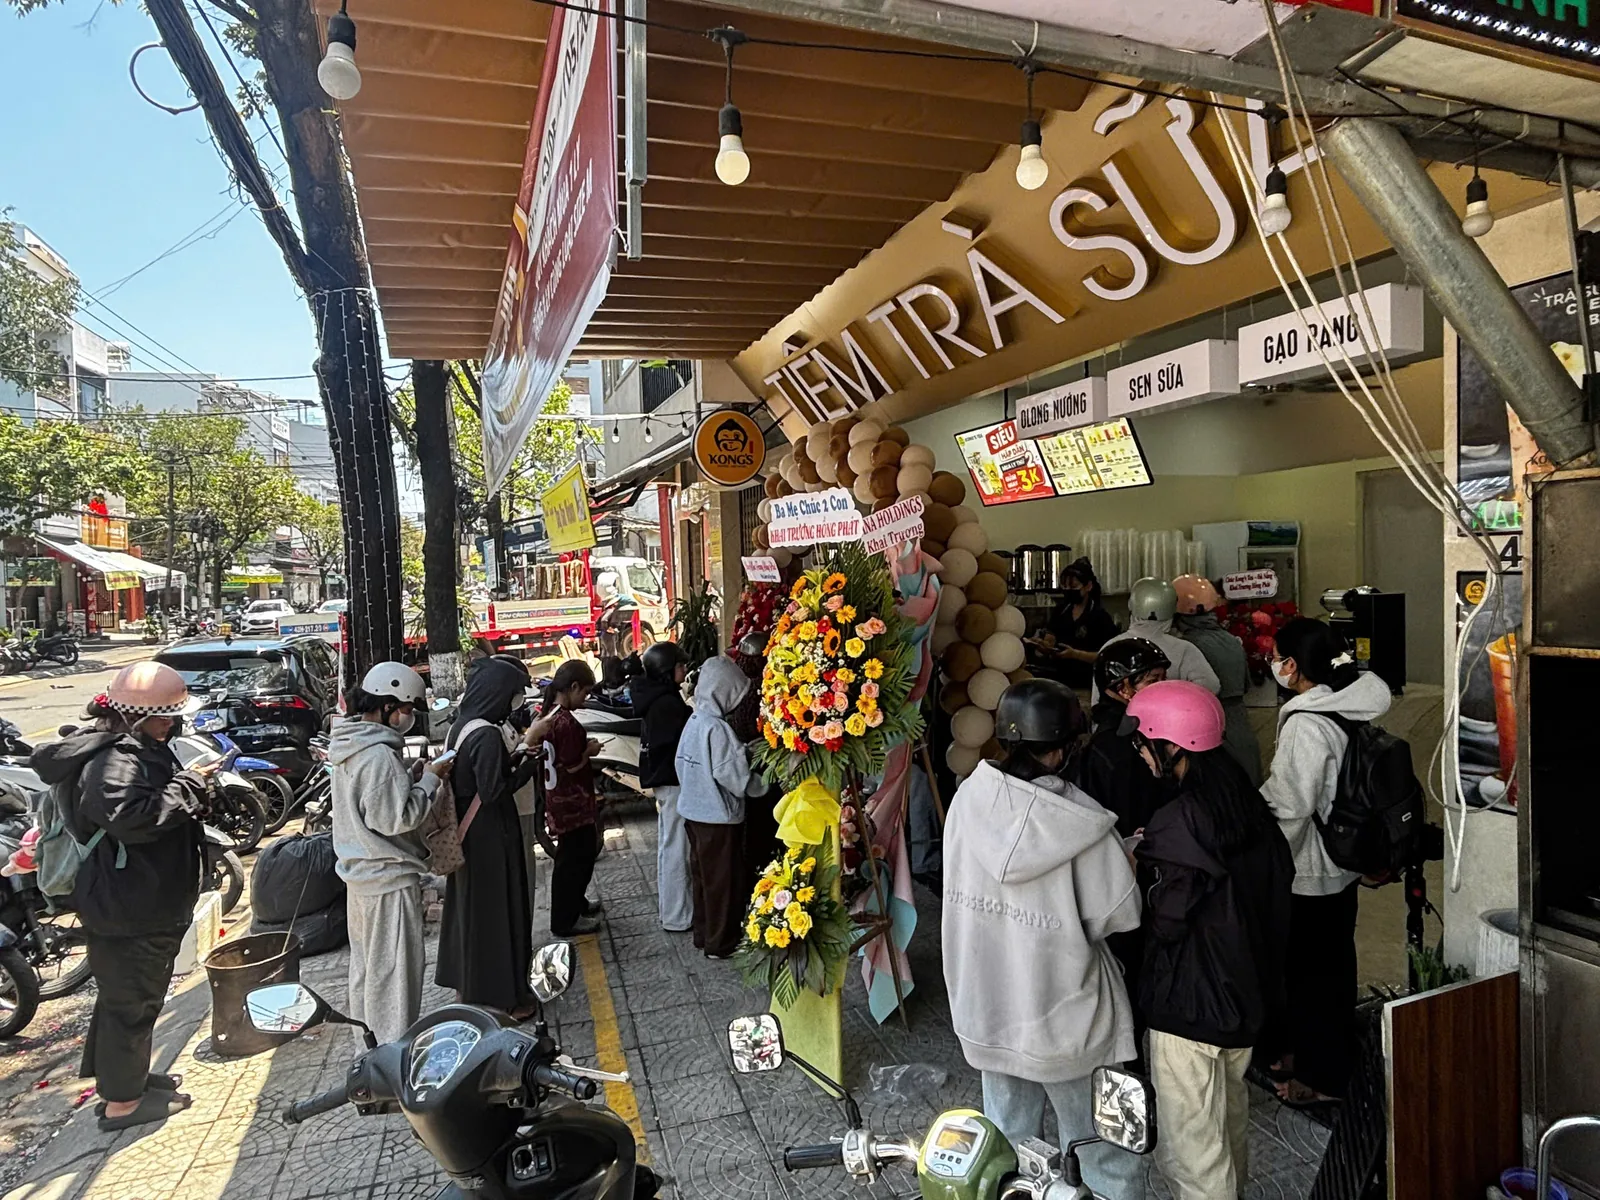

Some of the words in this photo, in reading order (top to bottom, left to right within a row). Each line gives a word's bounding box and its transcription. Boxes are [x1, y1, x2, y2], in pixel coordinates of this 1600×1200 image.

[865, 219, 1067, 380] TRÀ
[1264, 328, 1298, 364] GẠO
[1307, 313, 1359, 353] RANG
[1129, 374, 1152, 401] SEN
[1157, 362, 1184, 393] SỮA
[1020, 404, 1050, 430] OLONG
[1053, 392, 1087, 421] NƯỚNG
[989, 425, 1015, 451] SIÊU
[708, 453, 754, 465] KONG'S
[1025, 450, 1036, 468] 2
[1016, 467, 1041, 491] 3K
[774, 503, 786, 519] Ba
[786, 501, 799, 521] Mẹ
[799, 497, 821, 516] Chúc
[822, 498, 829, 513] 2
[830, 494, 849, 512] Con
[876, 495, 923, 529] HOLDINGS
[866, 534, 888, 554] Khai
[888, 523, 924, 545] Trương
